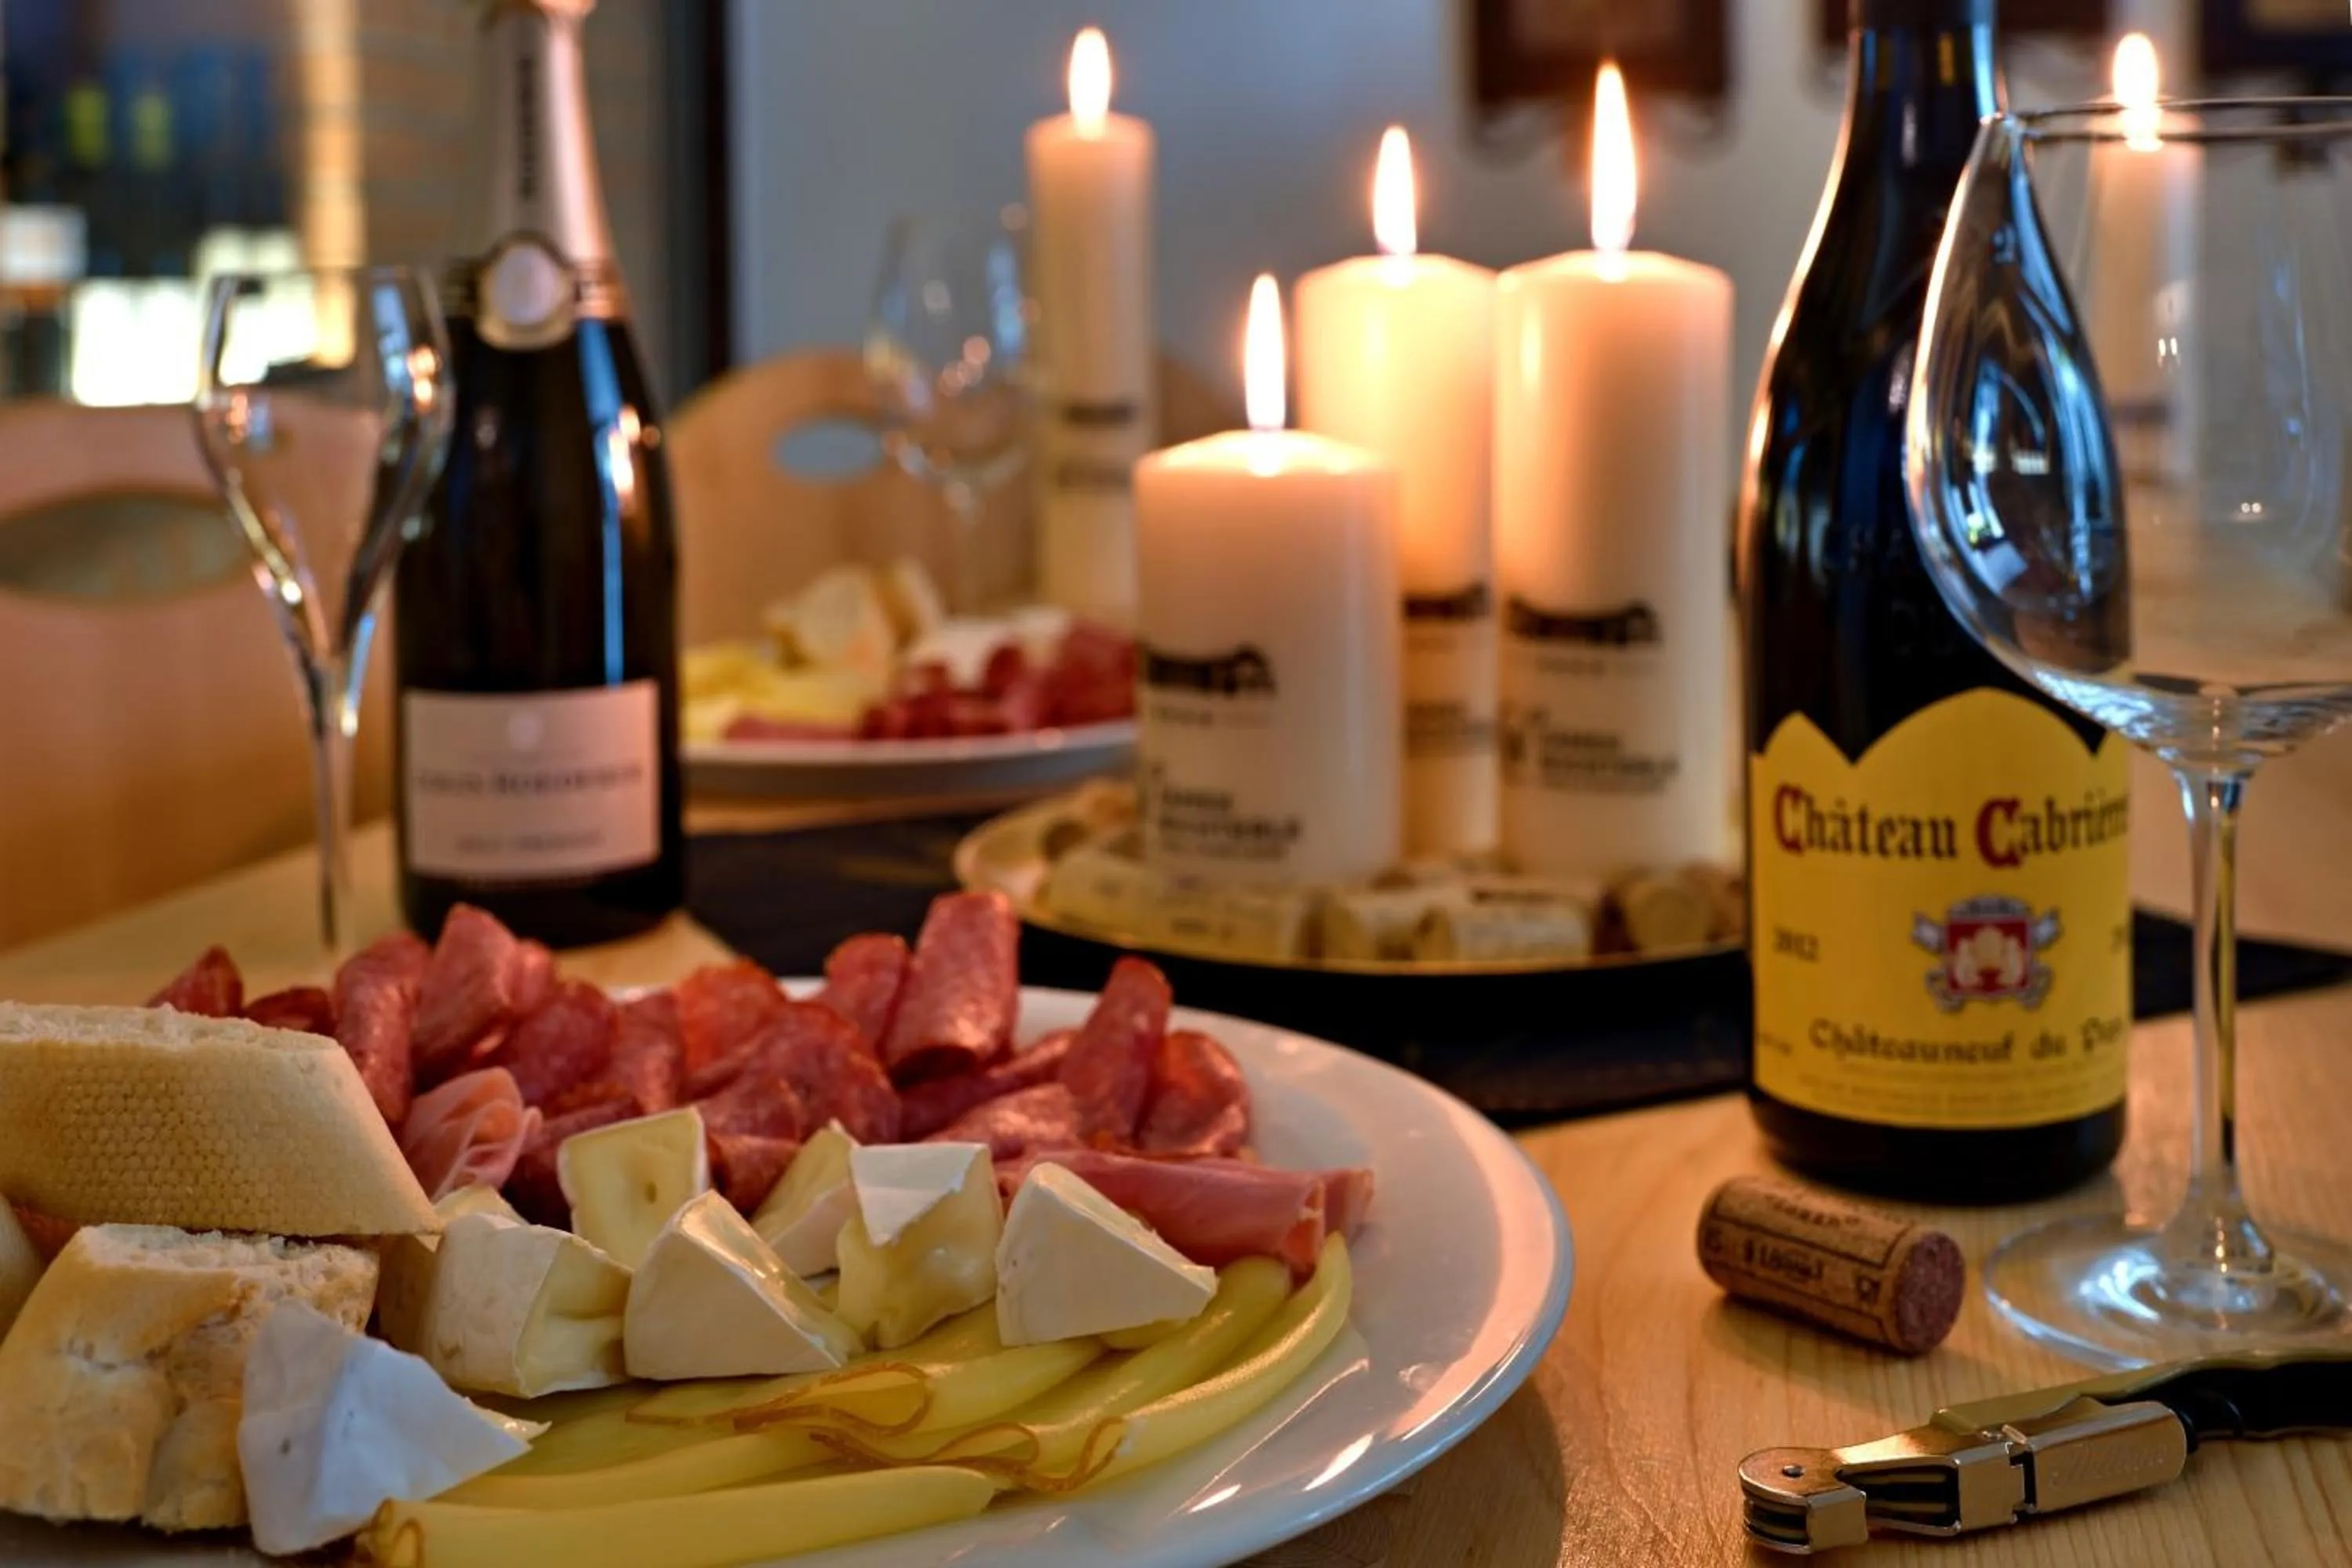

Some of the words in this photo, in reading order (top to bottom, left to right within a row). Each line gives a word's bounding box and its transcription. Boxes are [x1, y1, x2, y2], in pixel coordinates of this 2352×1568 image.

[1774, 784, 1958, 859] Château
[1808, 1018, 2016, 1064] Châteauneuf
[2029, 1029, 2067, 1061] du
